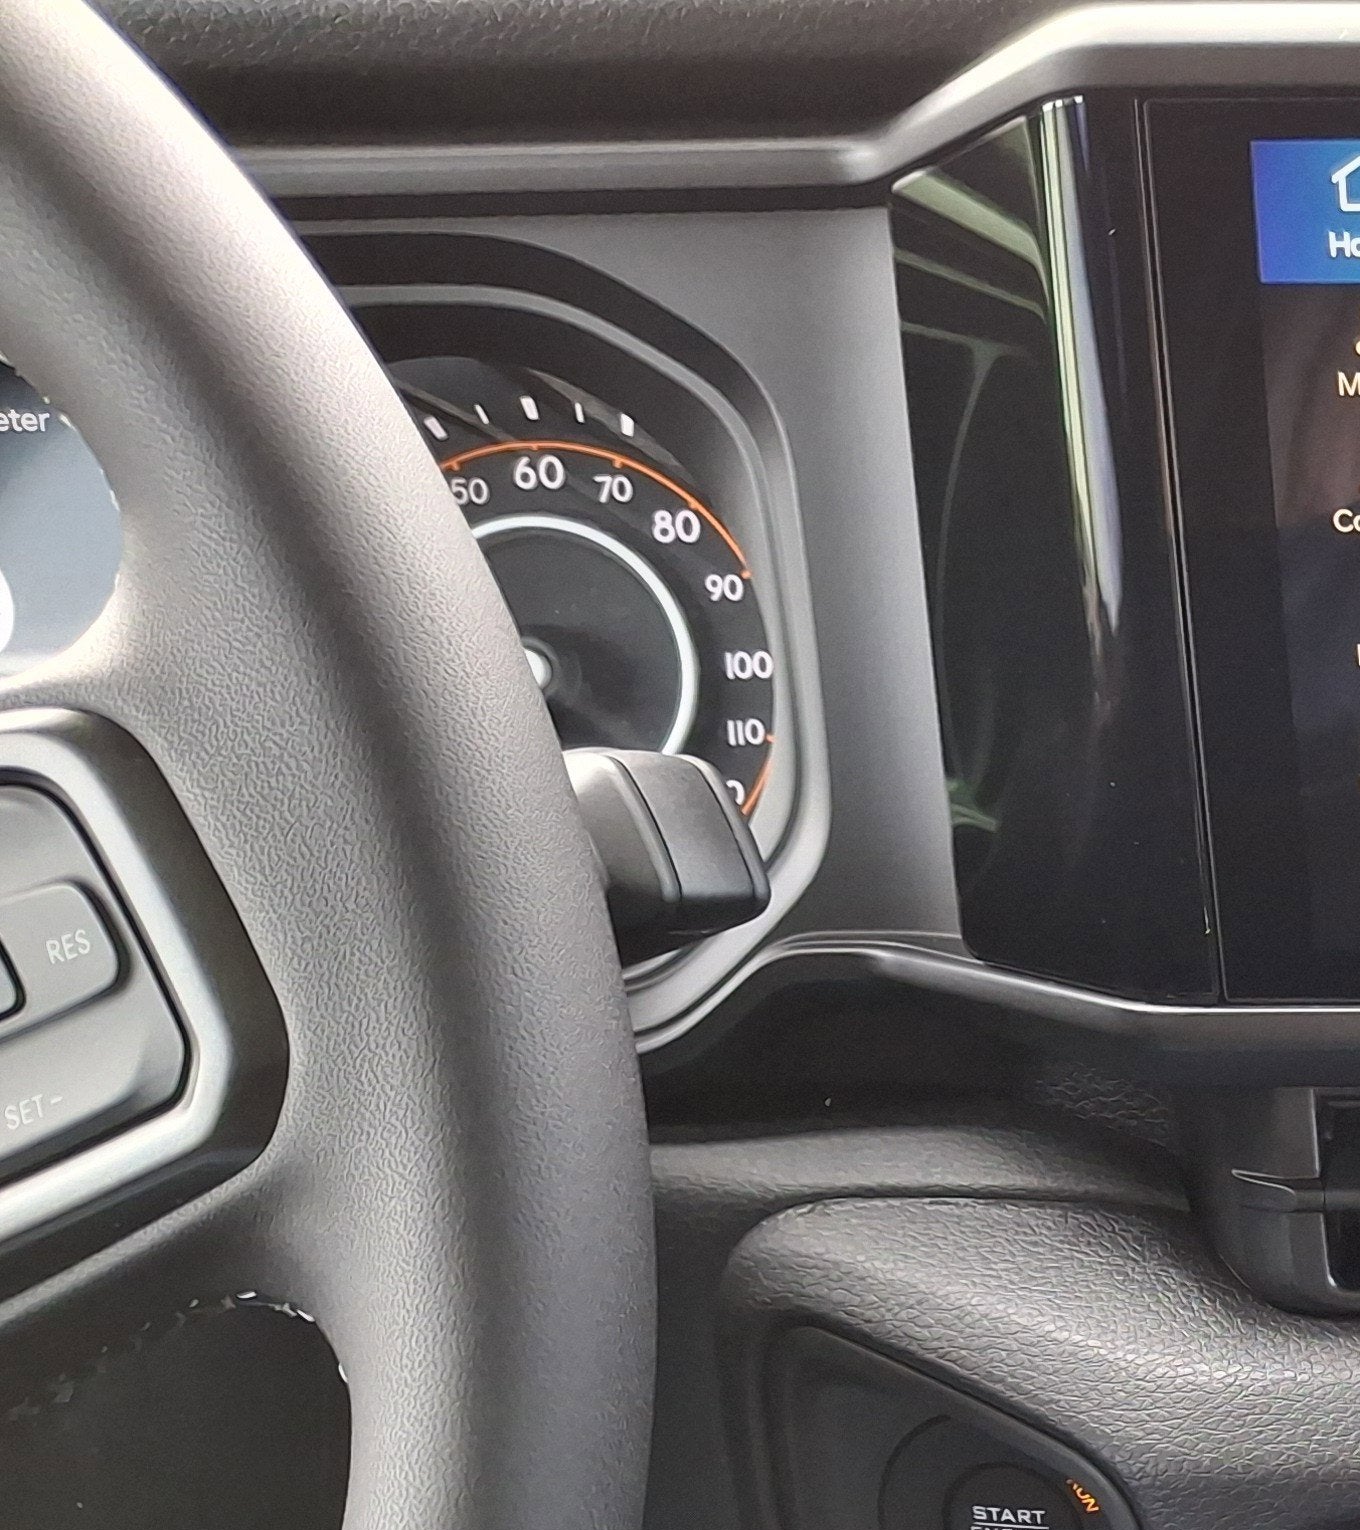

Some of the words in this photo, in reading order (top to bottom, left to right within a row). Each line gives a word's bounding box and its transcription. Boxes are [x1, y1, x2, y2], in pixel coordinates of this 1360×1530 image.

[513, 455, 566, 491] 60
[593, 473, 634, 504] 70
[450, 477, 490, 506] 50
[652, 509, 701, 543] 80
[704, 573, 744, 602] 90
[724, 650, 775, 681] 100
[726, 718, 766, 746] 110
[45, 929, 91, 965] RES
[971, 1505, 1046, 1525] START
